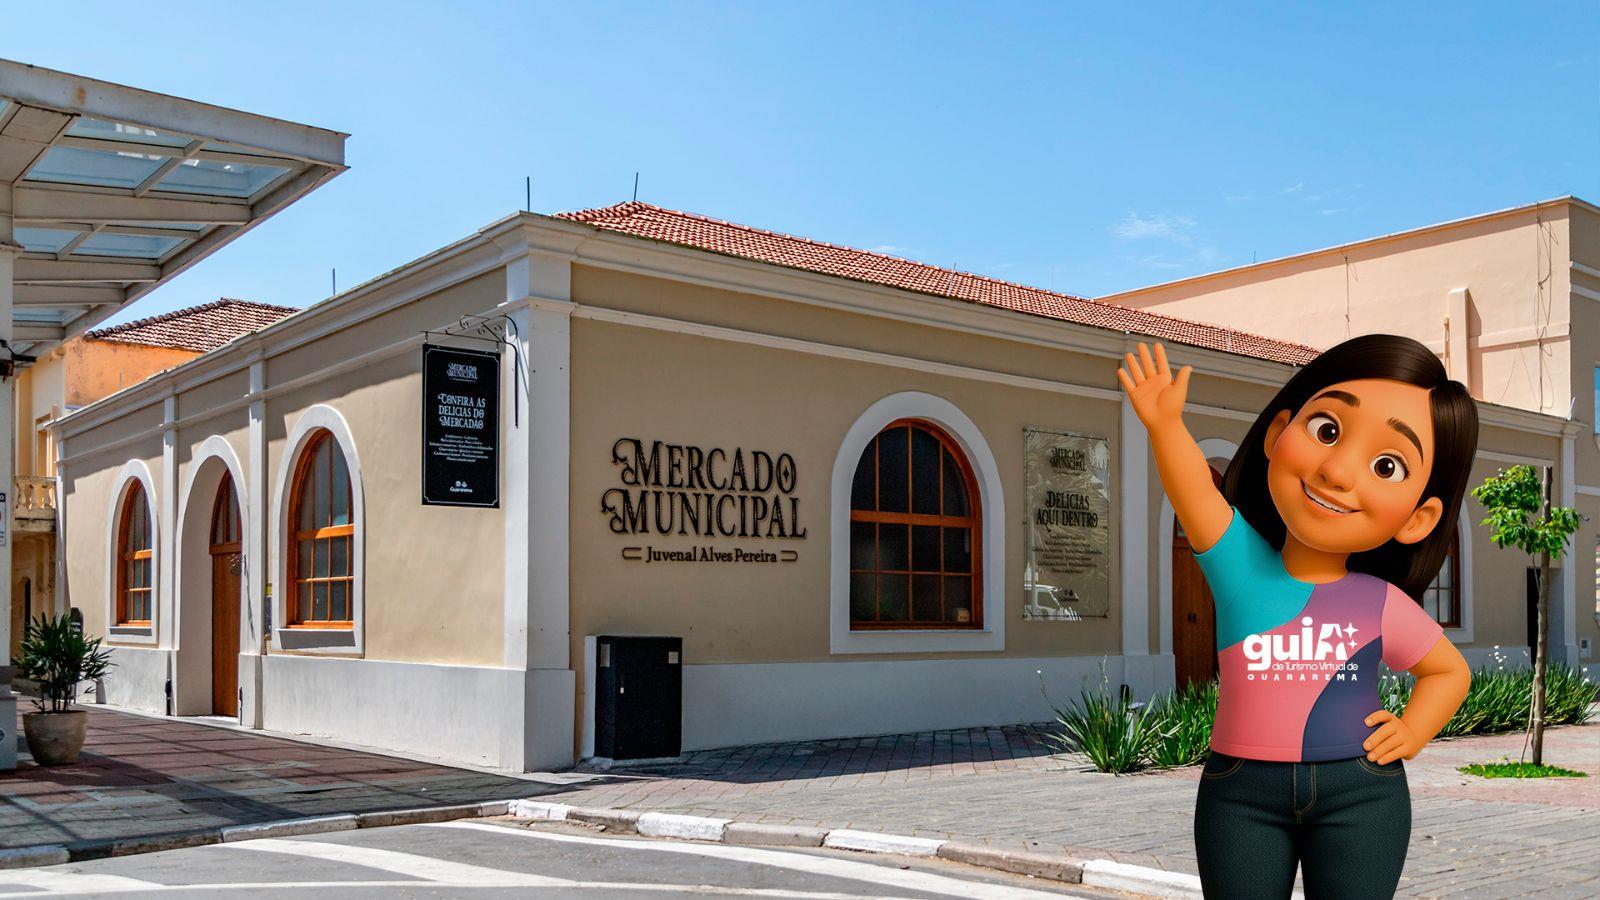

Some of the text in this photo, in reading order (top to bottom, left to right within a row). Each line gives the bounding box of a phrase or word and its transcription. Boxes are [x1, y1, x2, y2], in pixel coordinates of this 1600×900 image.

[438, 393, 486, 408] CONFIRA AS
[473, 408, 485, 418] DO
[1051, 448, 1085, 462] MERCADO
[612, 437, 797, 494] MERCADO
[1049, 457, 1087, 472] MUNICIPAL
[601, 488, 807, 539] MUNICIPAL
[1036, 508, 1099, 532] AQUI DENTRO
[646, 546, 777, 563] Juvenal Alves Pereira
[1272, 662, 1359, 671] de Turismo Virtual de
[1247, 673, 1358, 682] GUARAREMA
